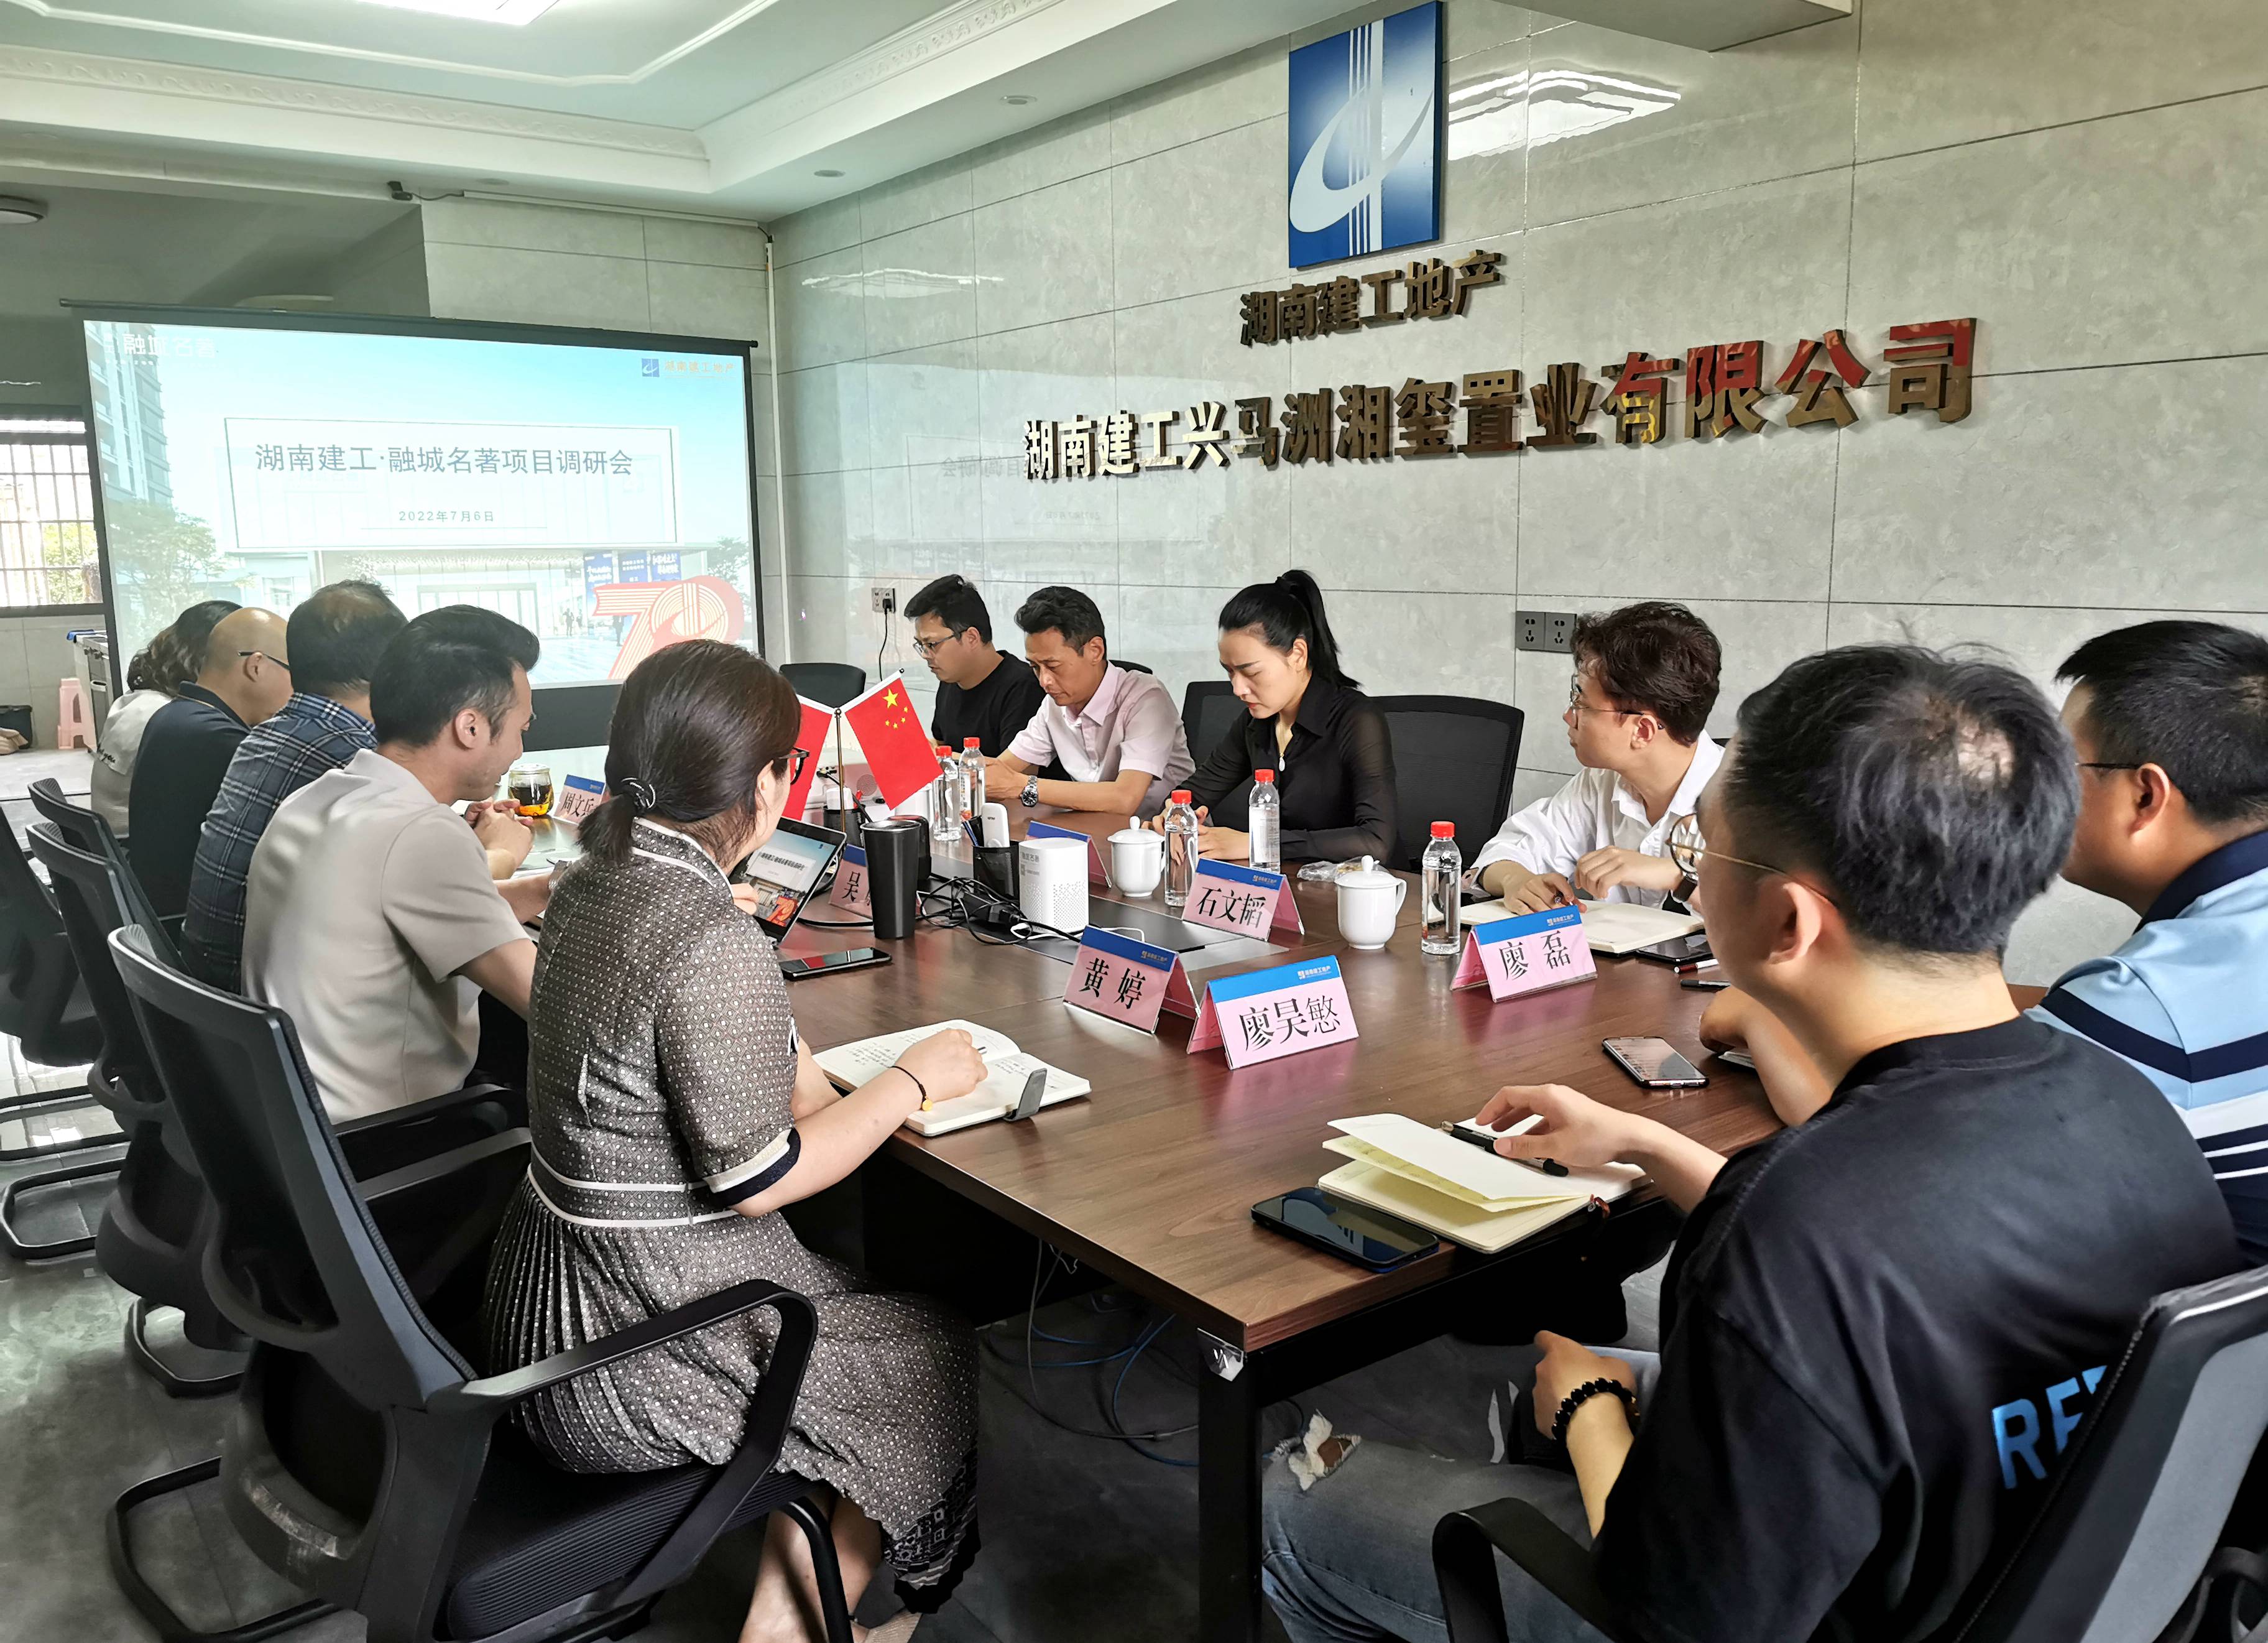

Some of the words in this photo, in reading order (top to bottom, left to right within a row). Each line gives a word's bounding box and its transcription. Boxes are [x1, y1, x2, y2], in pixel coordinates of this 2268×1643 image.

[1240, 249, 1502, 347] 湖南建工地产
[1024, 317, 1978, 480] 湖南建工兴马洲湘玺置业有限公司
[255, 443, 633, 475] 湖南建工·融城名著项目调研会
[399, 510, 495, 523] 2022年7月6日
[1196, 887, 1266, 928] 石文韬
[1499, 930, 1571, 981] 廖磊
[1079, 958, 1146, 1009] 黄婷
